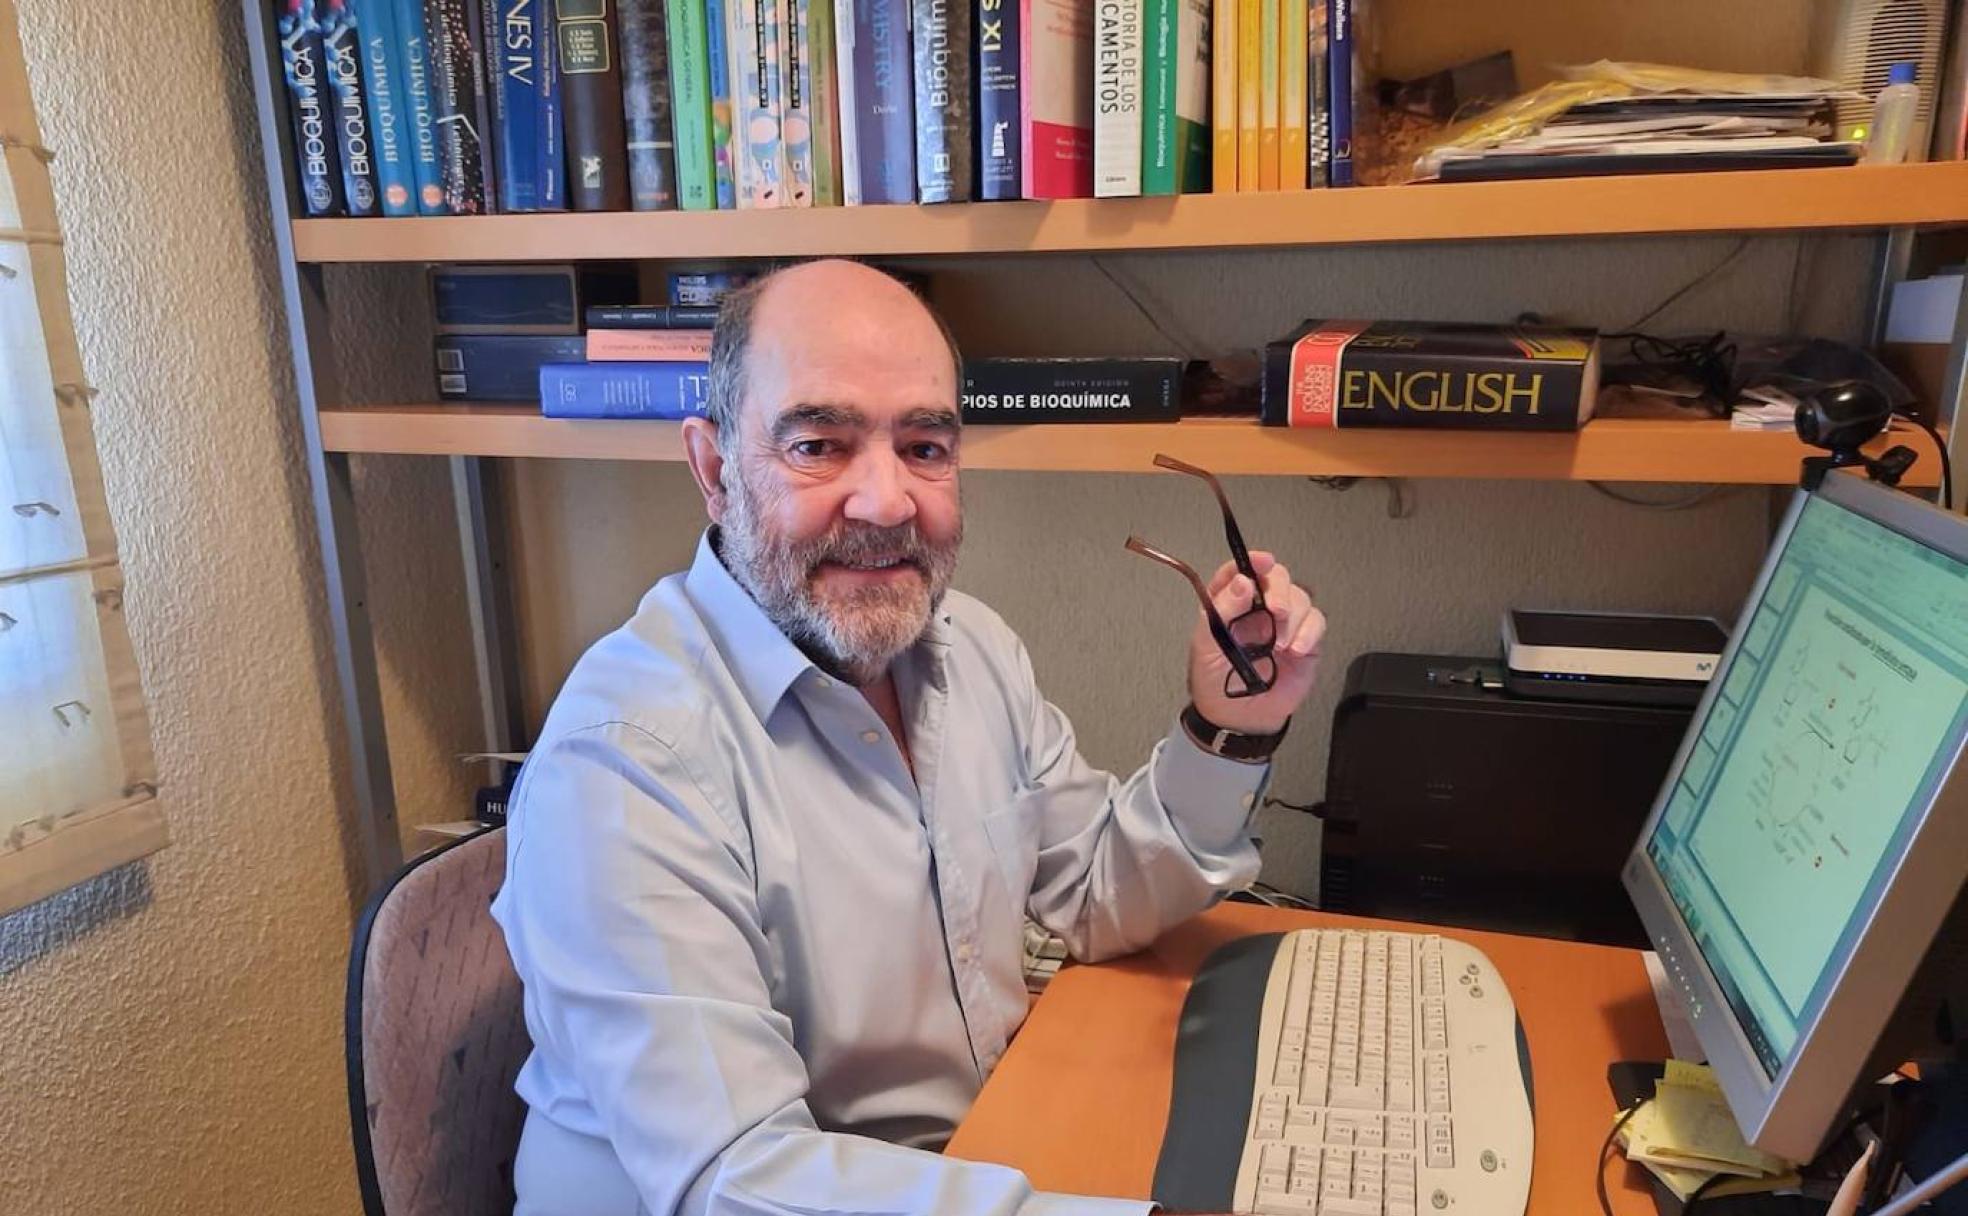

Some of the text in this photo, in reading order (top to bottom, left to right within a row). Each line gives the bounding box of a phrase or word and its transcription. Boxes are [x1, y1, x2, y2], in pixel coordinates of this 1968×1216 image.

[982, 19, 1001, 51] XI
[506, 56, 533, 85] IV
[1121, 58, 1136, 76] DE
[1121, 84, 1136, 113] LOS
[1003, 394, 1025, 409] DE
[1030, 390, 1132, 409] BIOQUÍMICA
[1341, 370, 1544, 416] ENGLISH
